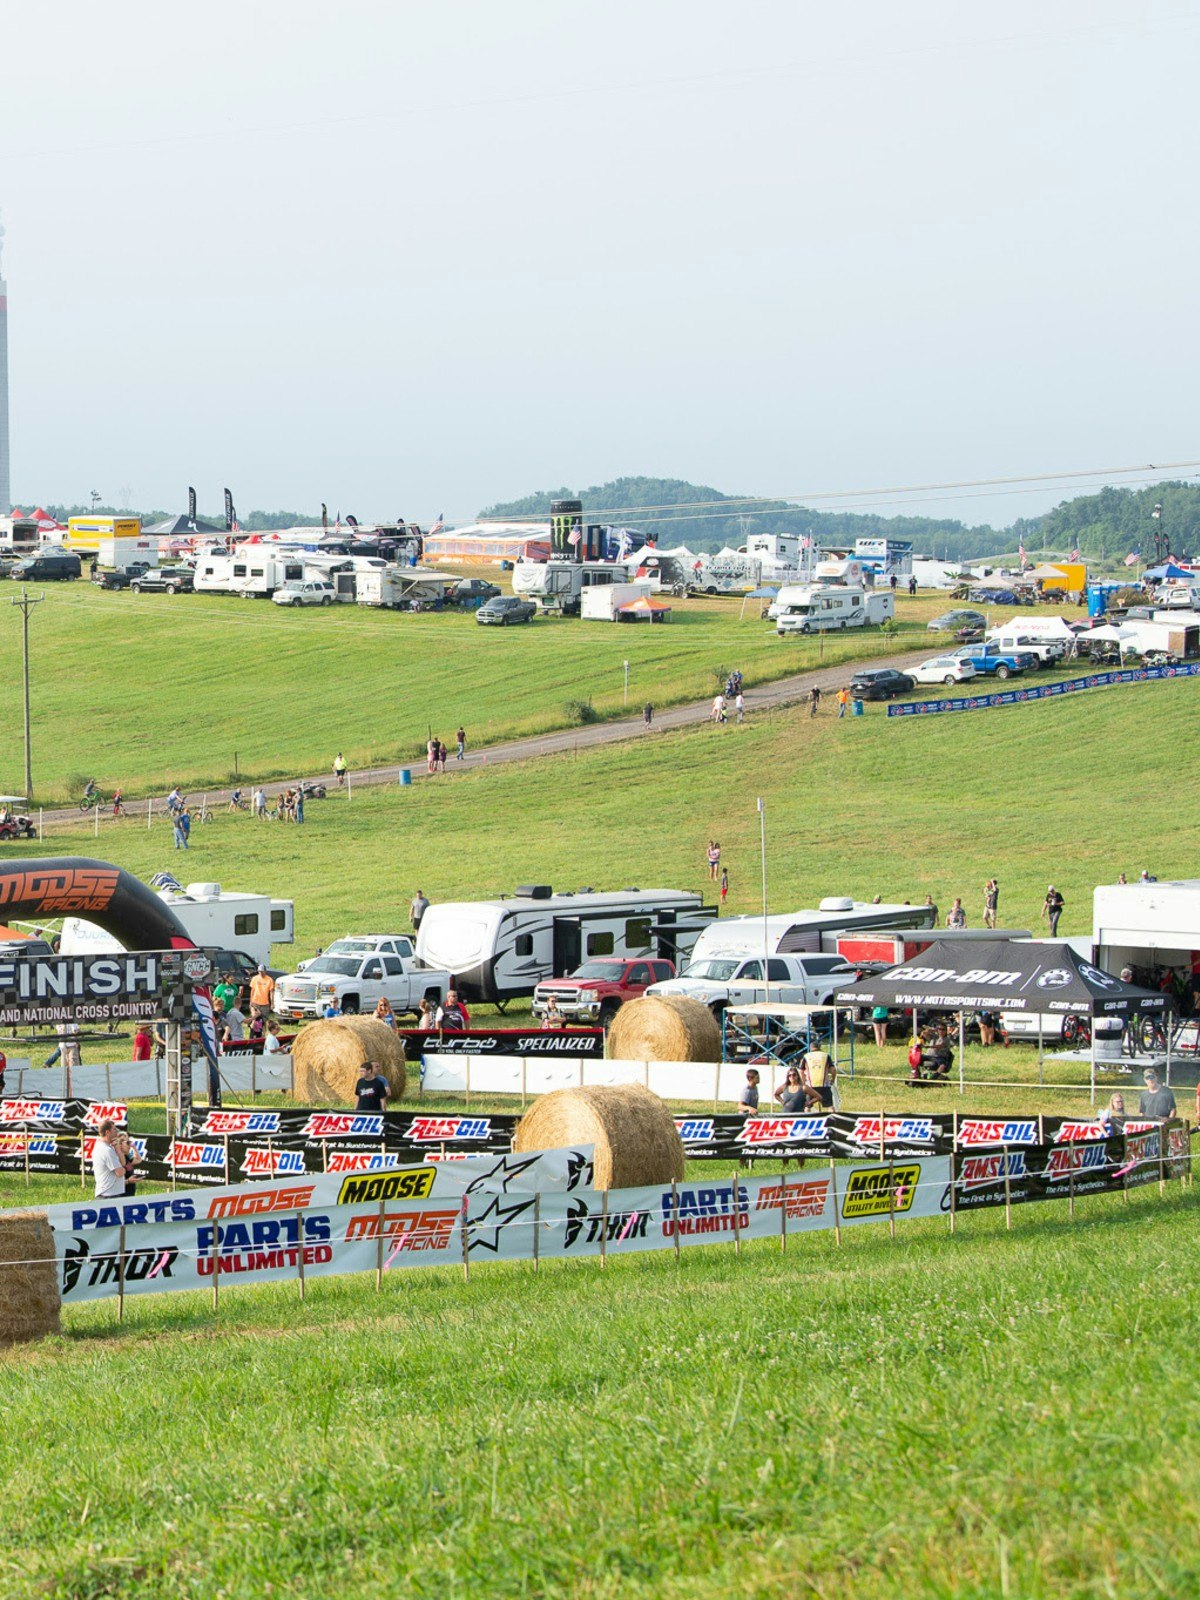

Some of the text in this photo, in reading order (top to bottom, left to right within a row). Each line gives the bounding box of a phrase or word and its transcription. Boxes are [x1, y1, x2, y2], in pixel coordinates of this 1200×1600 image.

[35, 897, 110, 912] RACING
[185, 960, 210, 971] GNCC
[23, 1006, 73, 1022] NATIONAL
[76, 1004, 110, 1018] CROSS
[112, 1002, 158, 1017] COUNTRY
[423, 1037, 596, 1051] turbo SPECIALIZED
[87, 1105, 128, 1124] AMS
[206, 1113, 278, 1133] AMSOIL
[305, 1115, 383, 1137] AMSOIL
[408, 1119, 488, 1139] AMSOIL
[742, 1118, 828, 1143] AMSOIL
[855, 1119, 932, 1142] AMSOIL
[958, 1122, 1036, 1145] AMSOIL
[168, 1144, 225, 1168] AMSOIL
[245, 1150, 305, 1173] AMSOIL
[329, 1153, 398, 1172] AMSOIL
[785, 1148, 827, 1156] Synthetics
[1046, 1144, 1108, 1178] AMSOIL
[1, 1161, 16, 1169] First
[960, 1153, 1027, 1187] AMSOIL
[341, 1170, 431, 1204] MOOSE
[755, 1179, 830, 1211] MOOSE
[848, 1171, 916, 1202] MOOSE
[958, 1190, 1026, 1204] The First in Synhetics
[1045, 1186, 1056, 1194] The
[206, 1185, 316, 1219] MOOSE
[662, 1187, 749, 1218] PARTS
[785, 1203, 825, 1219] RACING
[846, 1202, 873, 1213] UTILITY
[72, 1198, 196, 1230] PARTS
[662, 1212, 750, 1237] UNLIMITED
[197, 1215, 331, 1255] PARTS
[345, 1209, 459, 1243] MOOSE
[388, 1232, 450, 1252] RACING
[89, 1246, 179, 1285] THOR
[197, 1245, 332, 1276] UNLIMITED
